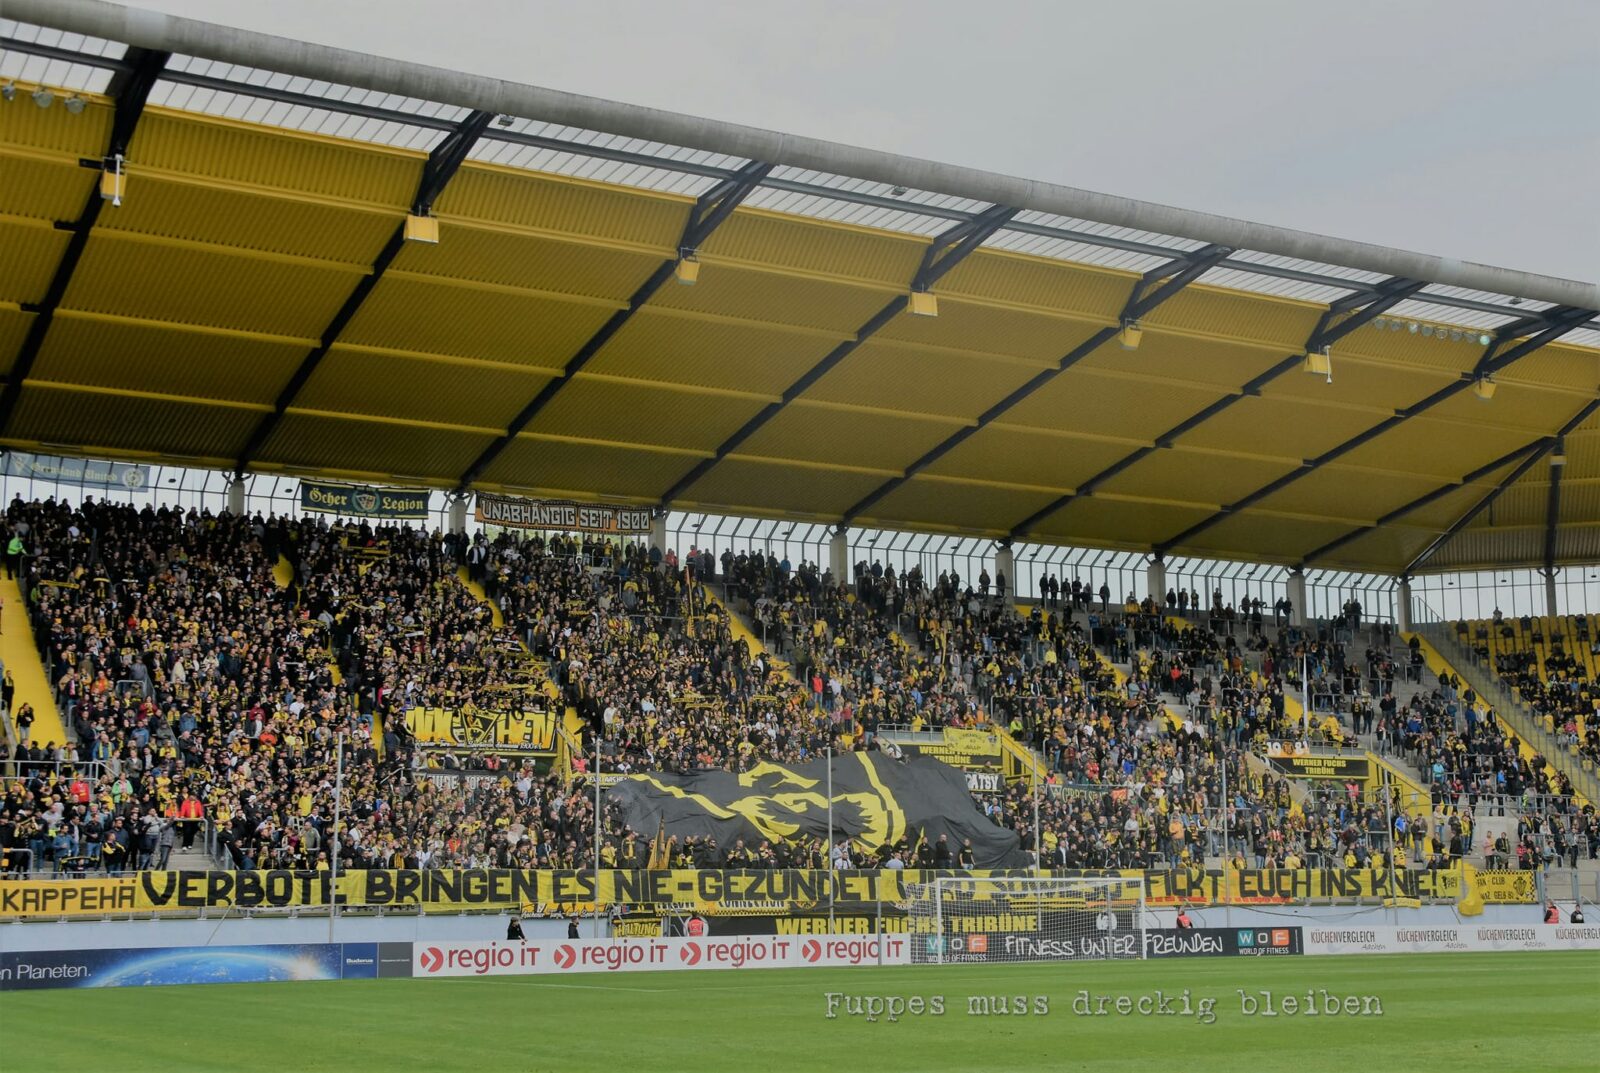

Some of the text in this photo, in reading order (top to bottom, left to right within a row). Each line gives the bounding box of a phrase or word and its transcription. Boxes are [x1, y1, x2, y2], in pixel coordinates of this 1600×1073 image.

[309, 487, 424, 512] Öcher Legion
[481, 500, 650, 530] UNABHÄNGIG SEIT 1900
[1293, 759, 1323, 767] WERNER
[1305, 767, 1335, 775] TRIBÜNE
[2, 880, 136, 912] KAPPEHÄ
[142, 870, 347, 907] VERBOTE
[366, 869, 538, 903] BRINGEN
[553, 869, 597, 902] ES
[1239, 868, 1312, 898] EUCH
[1320, 868, 1363, 897] INS
[1371, 867, 1437, 898] KNIE!
[776, 913, 1038, 935] WERNER FUCHS TRIBÜNE
[1397, 928, 1458, 943] KÜCHENVERGLEICH
[1478, 927, 1536, 941] KÜCHENVERGLEICH
[1005, 932, 1223, 956] FITNESS UNTER FREUNDEN
[1311, 929, 1376, 944] KÜCHENVERGLEICH
[448, 942, 514, 974] regio
[582, 939, 644, 970] regio
[707, 936, 767, 967] regio
[826, 935, 879, 964] regio
[961, 953, 987, 961] FITNESS
[17, 964, 92, 981] Planeten.
